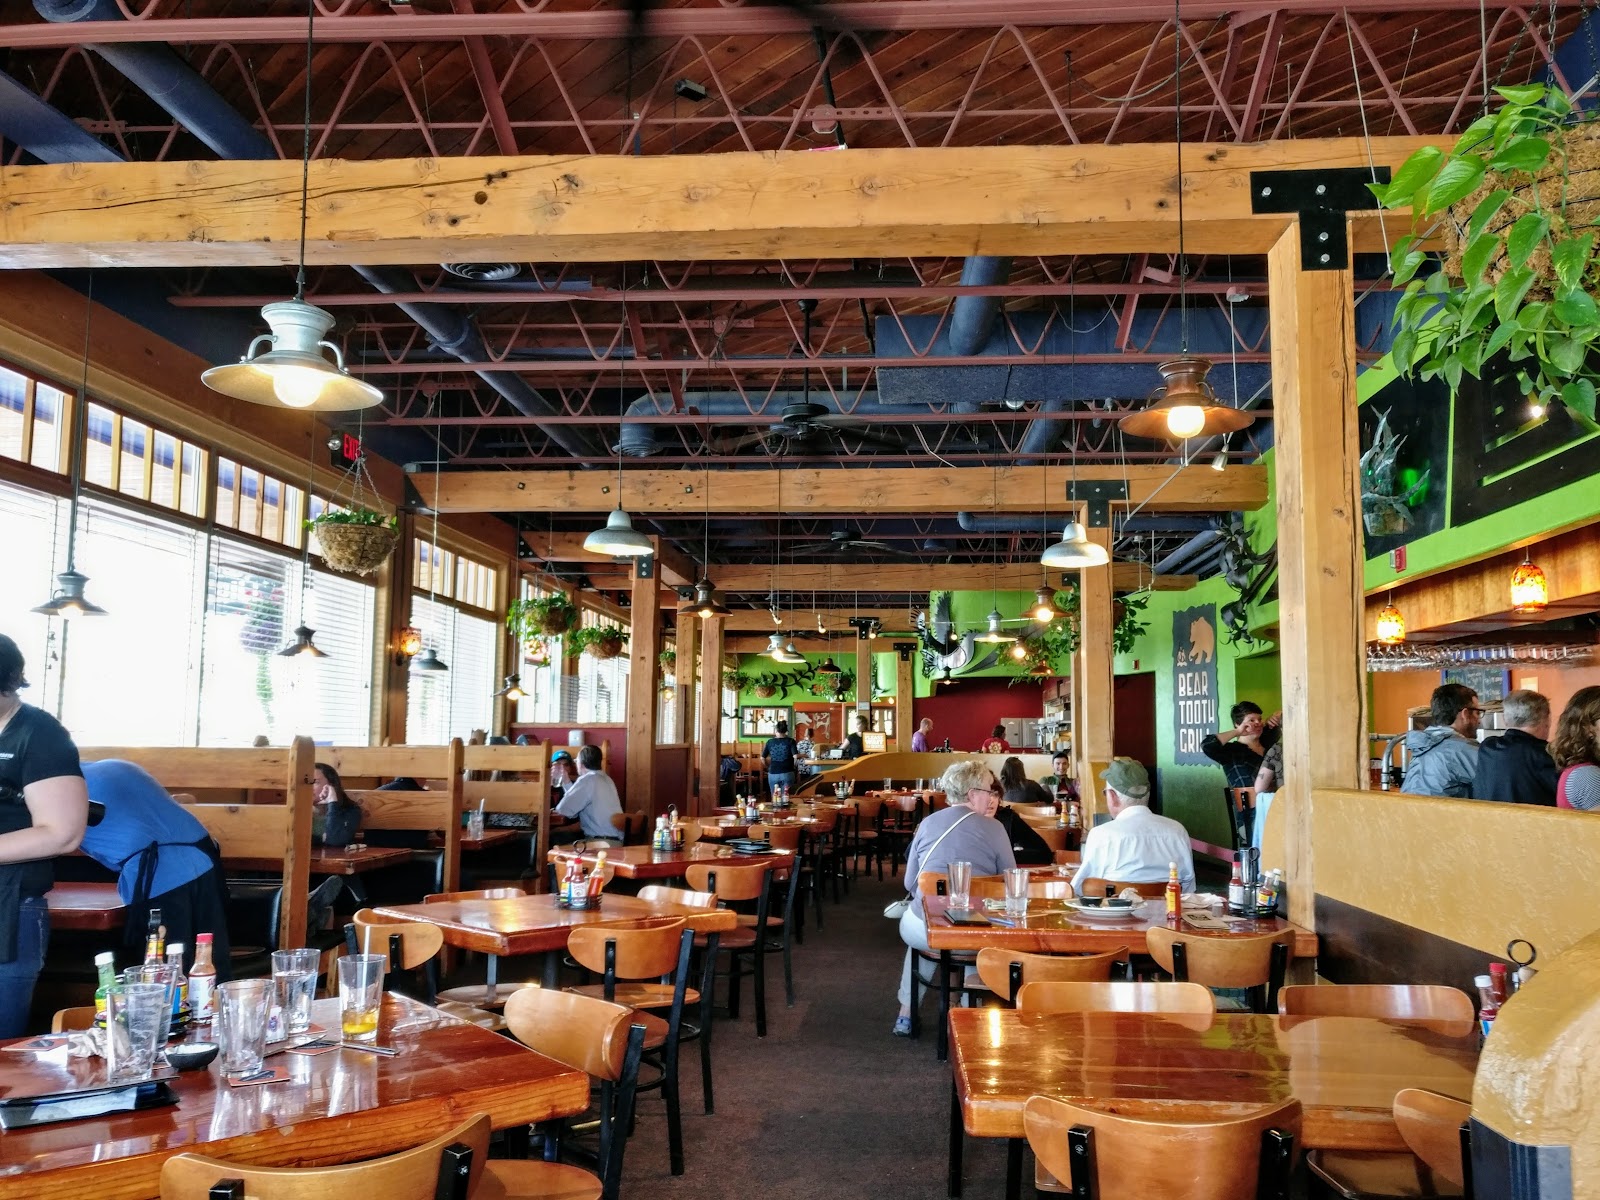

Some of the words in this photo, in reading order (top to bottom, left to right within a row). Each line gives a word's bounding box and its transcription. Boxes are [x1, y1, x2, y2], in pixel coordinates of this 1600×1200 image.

[1178, 671, 1208, 697] BEAR
[1178, 699, 1215, 725] TOOTH
[1179, 728, 1210, 753] GRIL
